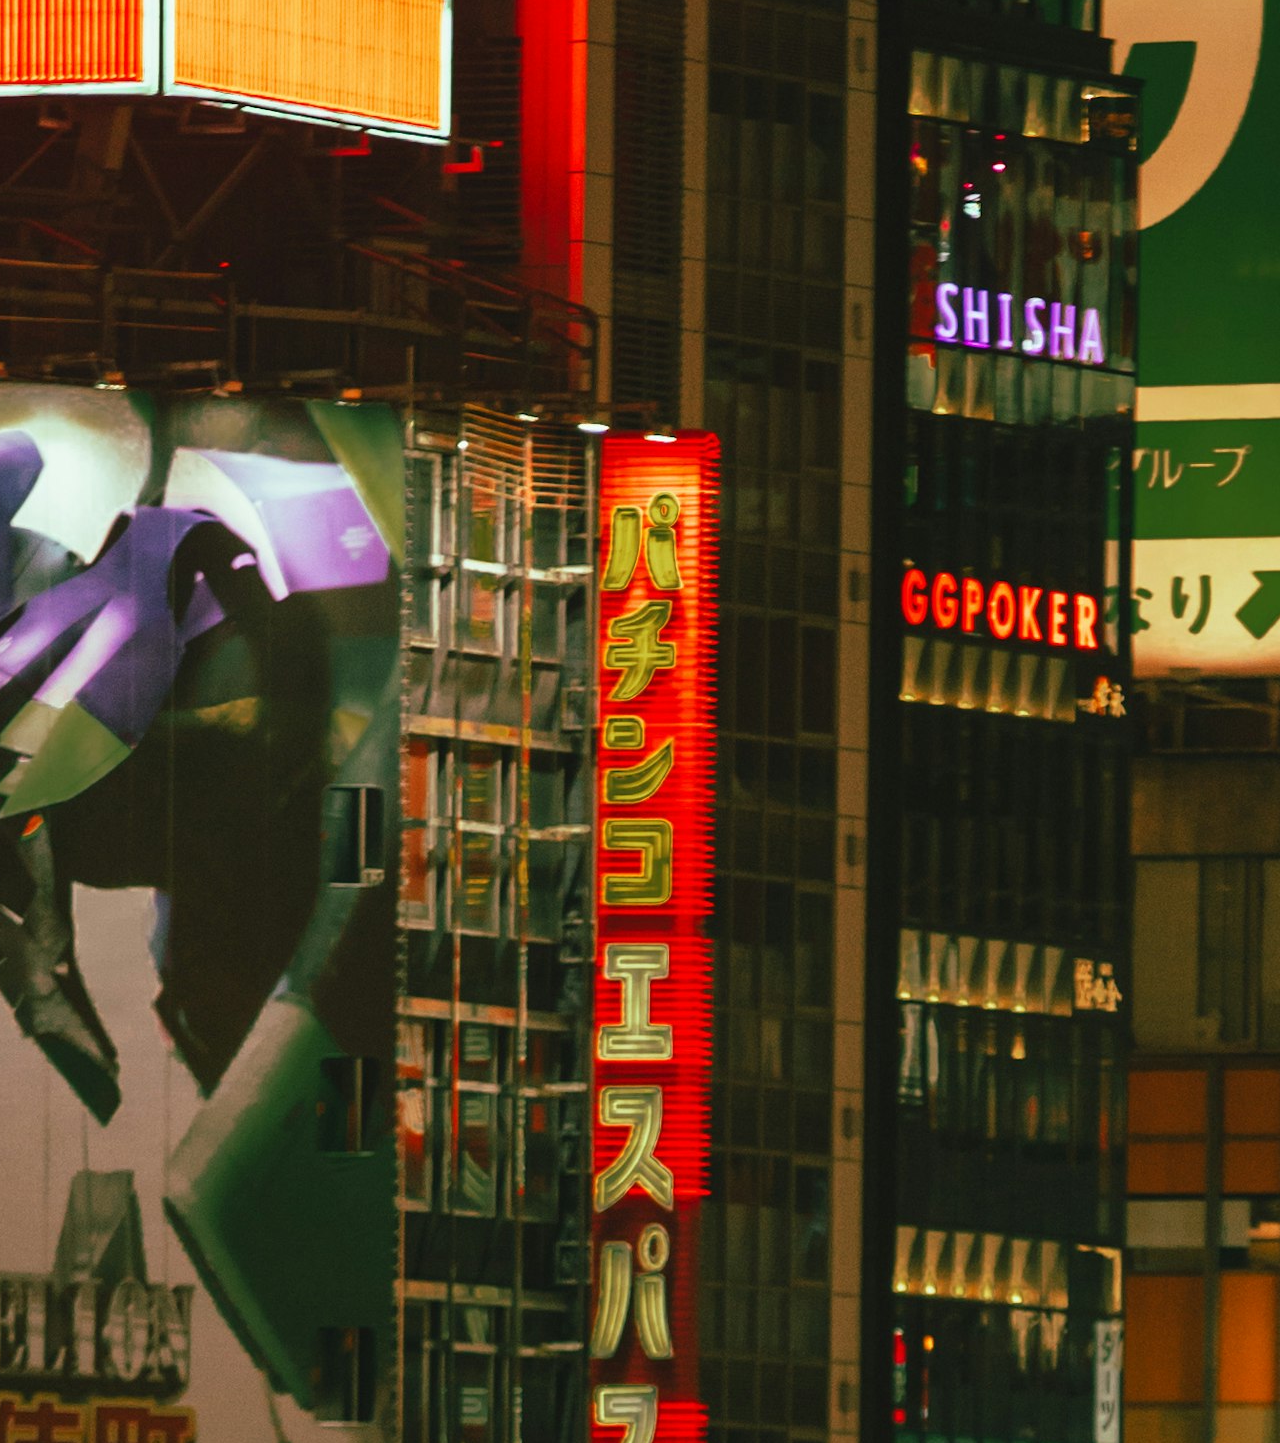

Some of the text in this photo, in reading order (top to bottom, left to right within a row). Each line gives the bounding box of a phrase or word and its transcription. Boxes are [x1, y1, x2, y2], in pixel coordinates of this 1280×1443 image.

[934, 281, 1106, 365] SHISHA
[900, 567, 1099, 650] GGPOKER
[601, 491, 683, 905] パチンコ
